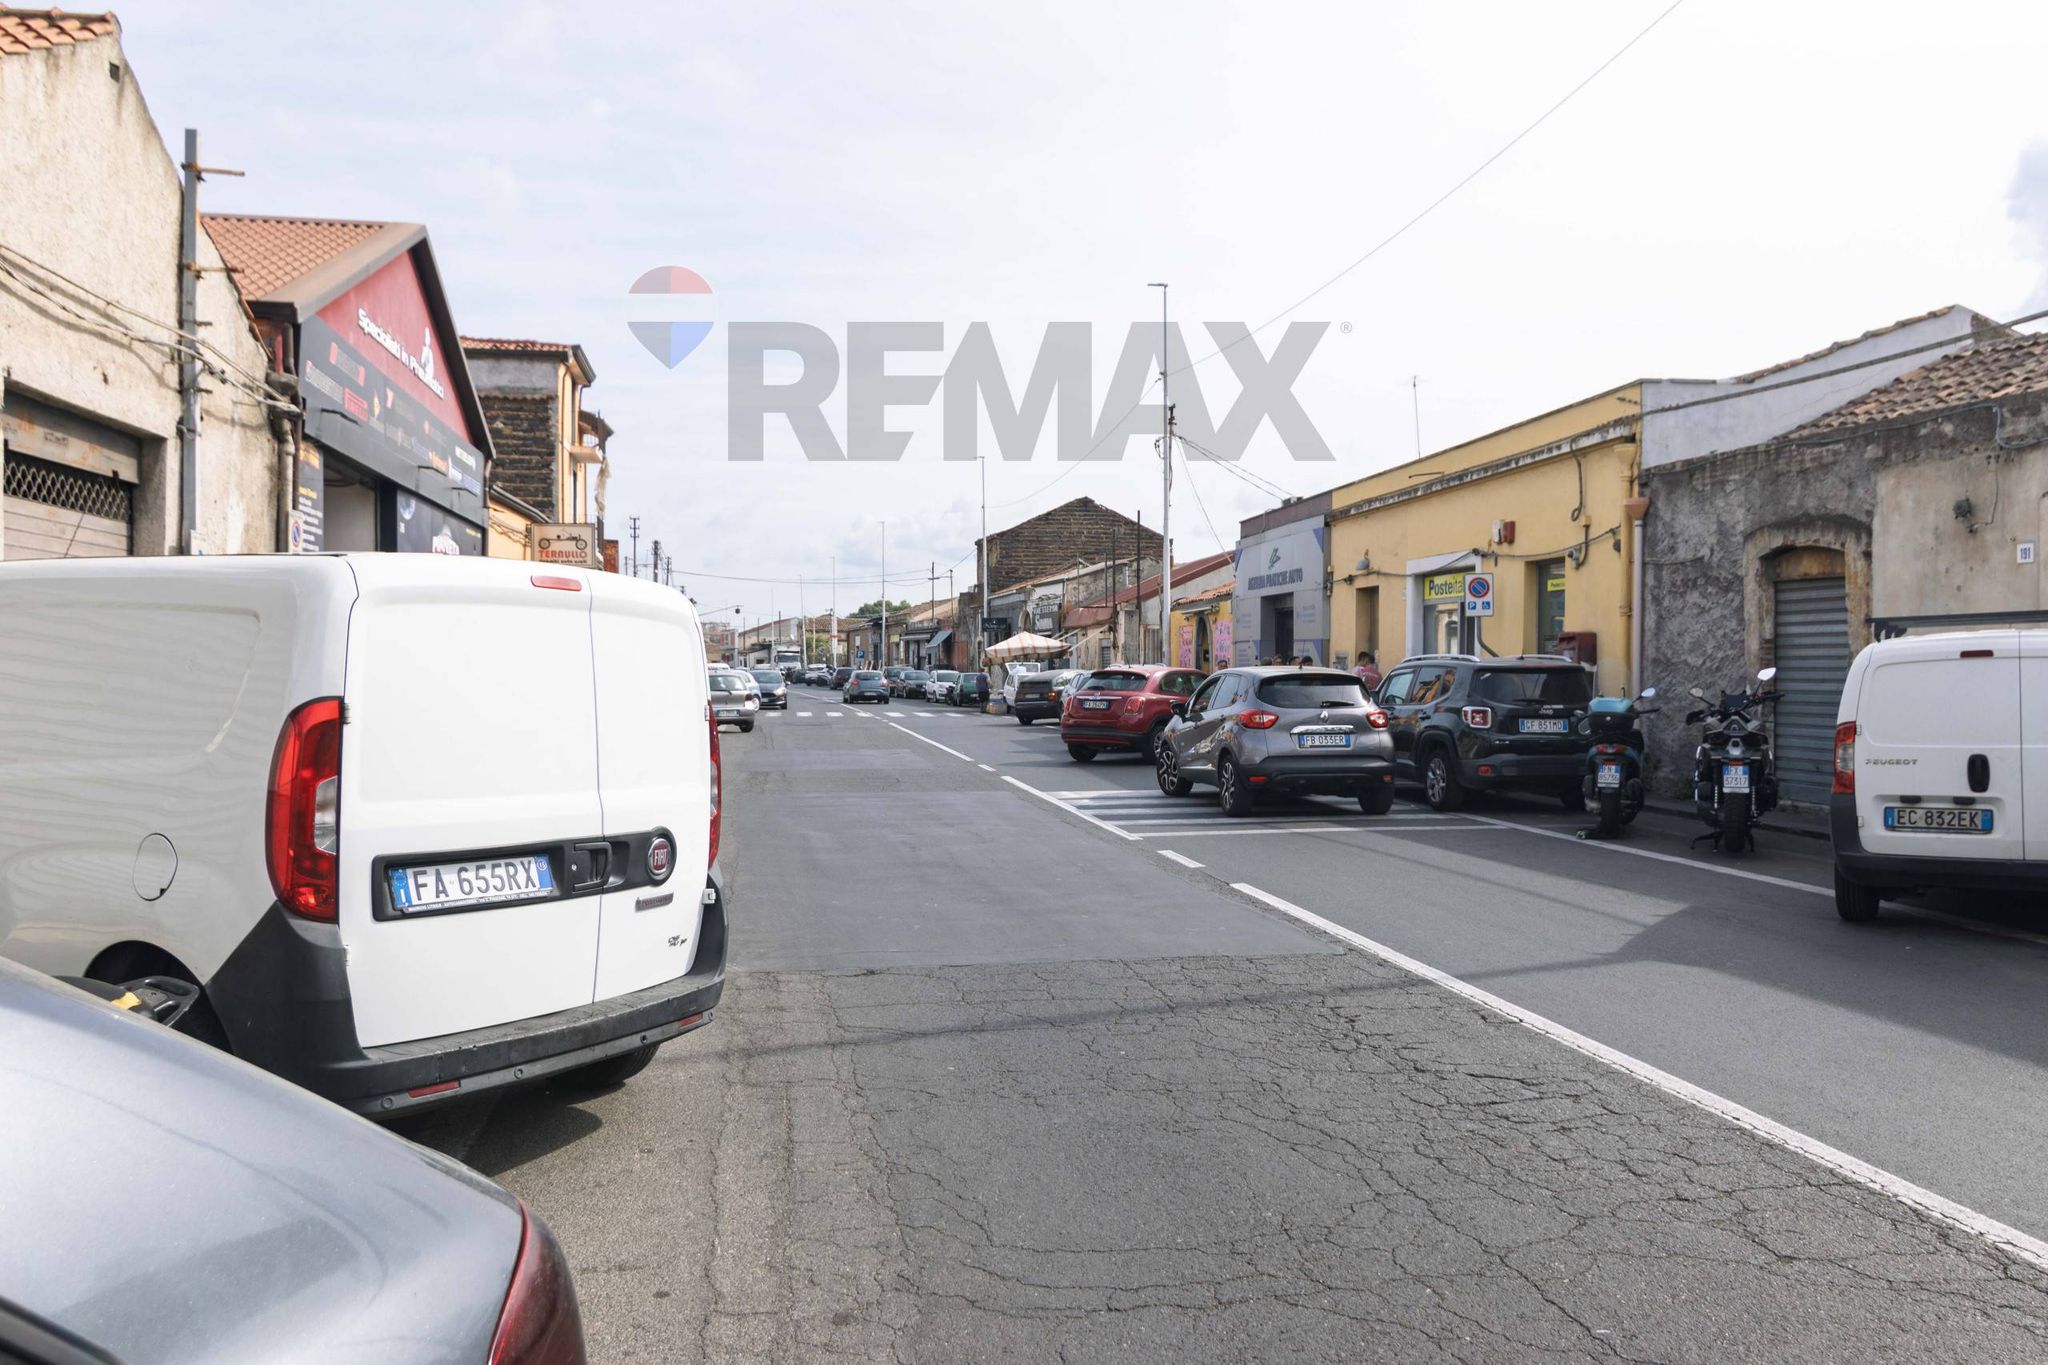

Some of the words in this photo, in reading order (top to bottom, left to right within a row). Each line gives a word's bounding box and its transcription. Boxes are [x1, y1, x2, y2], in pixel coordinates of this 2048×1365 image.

[1288, 567, 1303, 585] AUTO
[1896, 809, 1918, 825] EC
[1924, 810, 1979, 828] 832EK
[654, 848, 668, 866] FIAT
[413, 868, 450, 901] FA
[457, 859, 537, 896] 655RX
